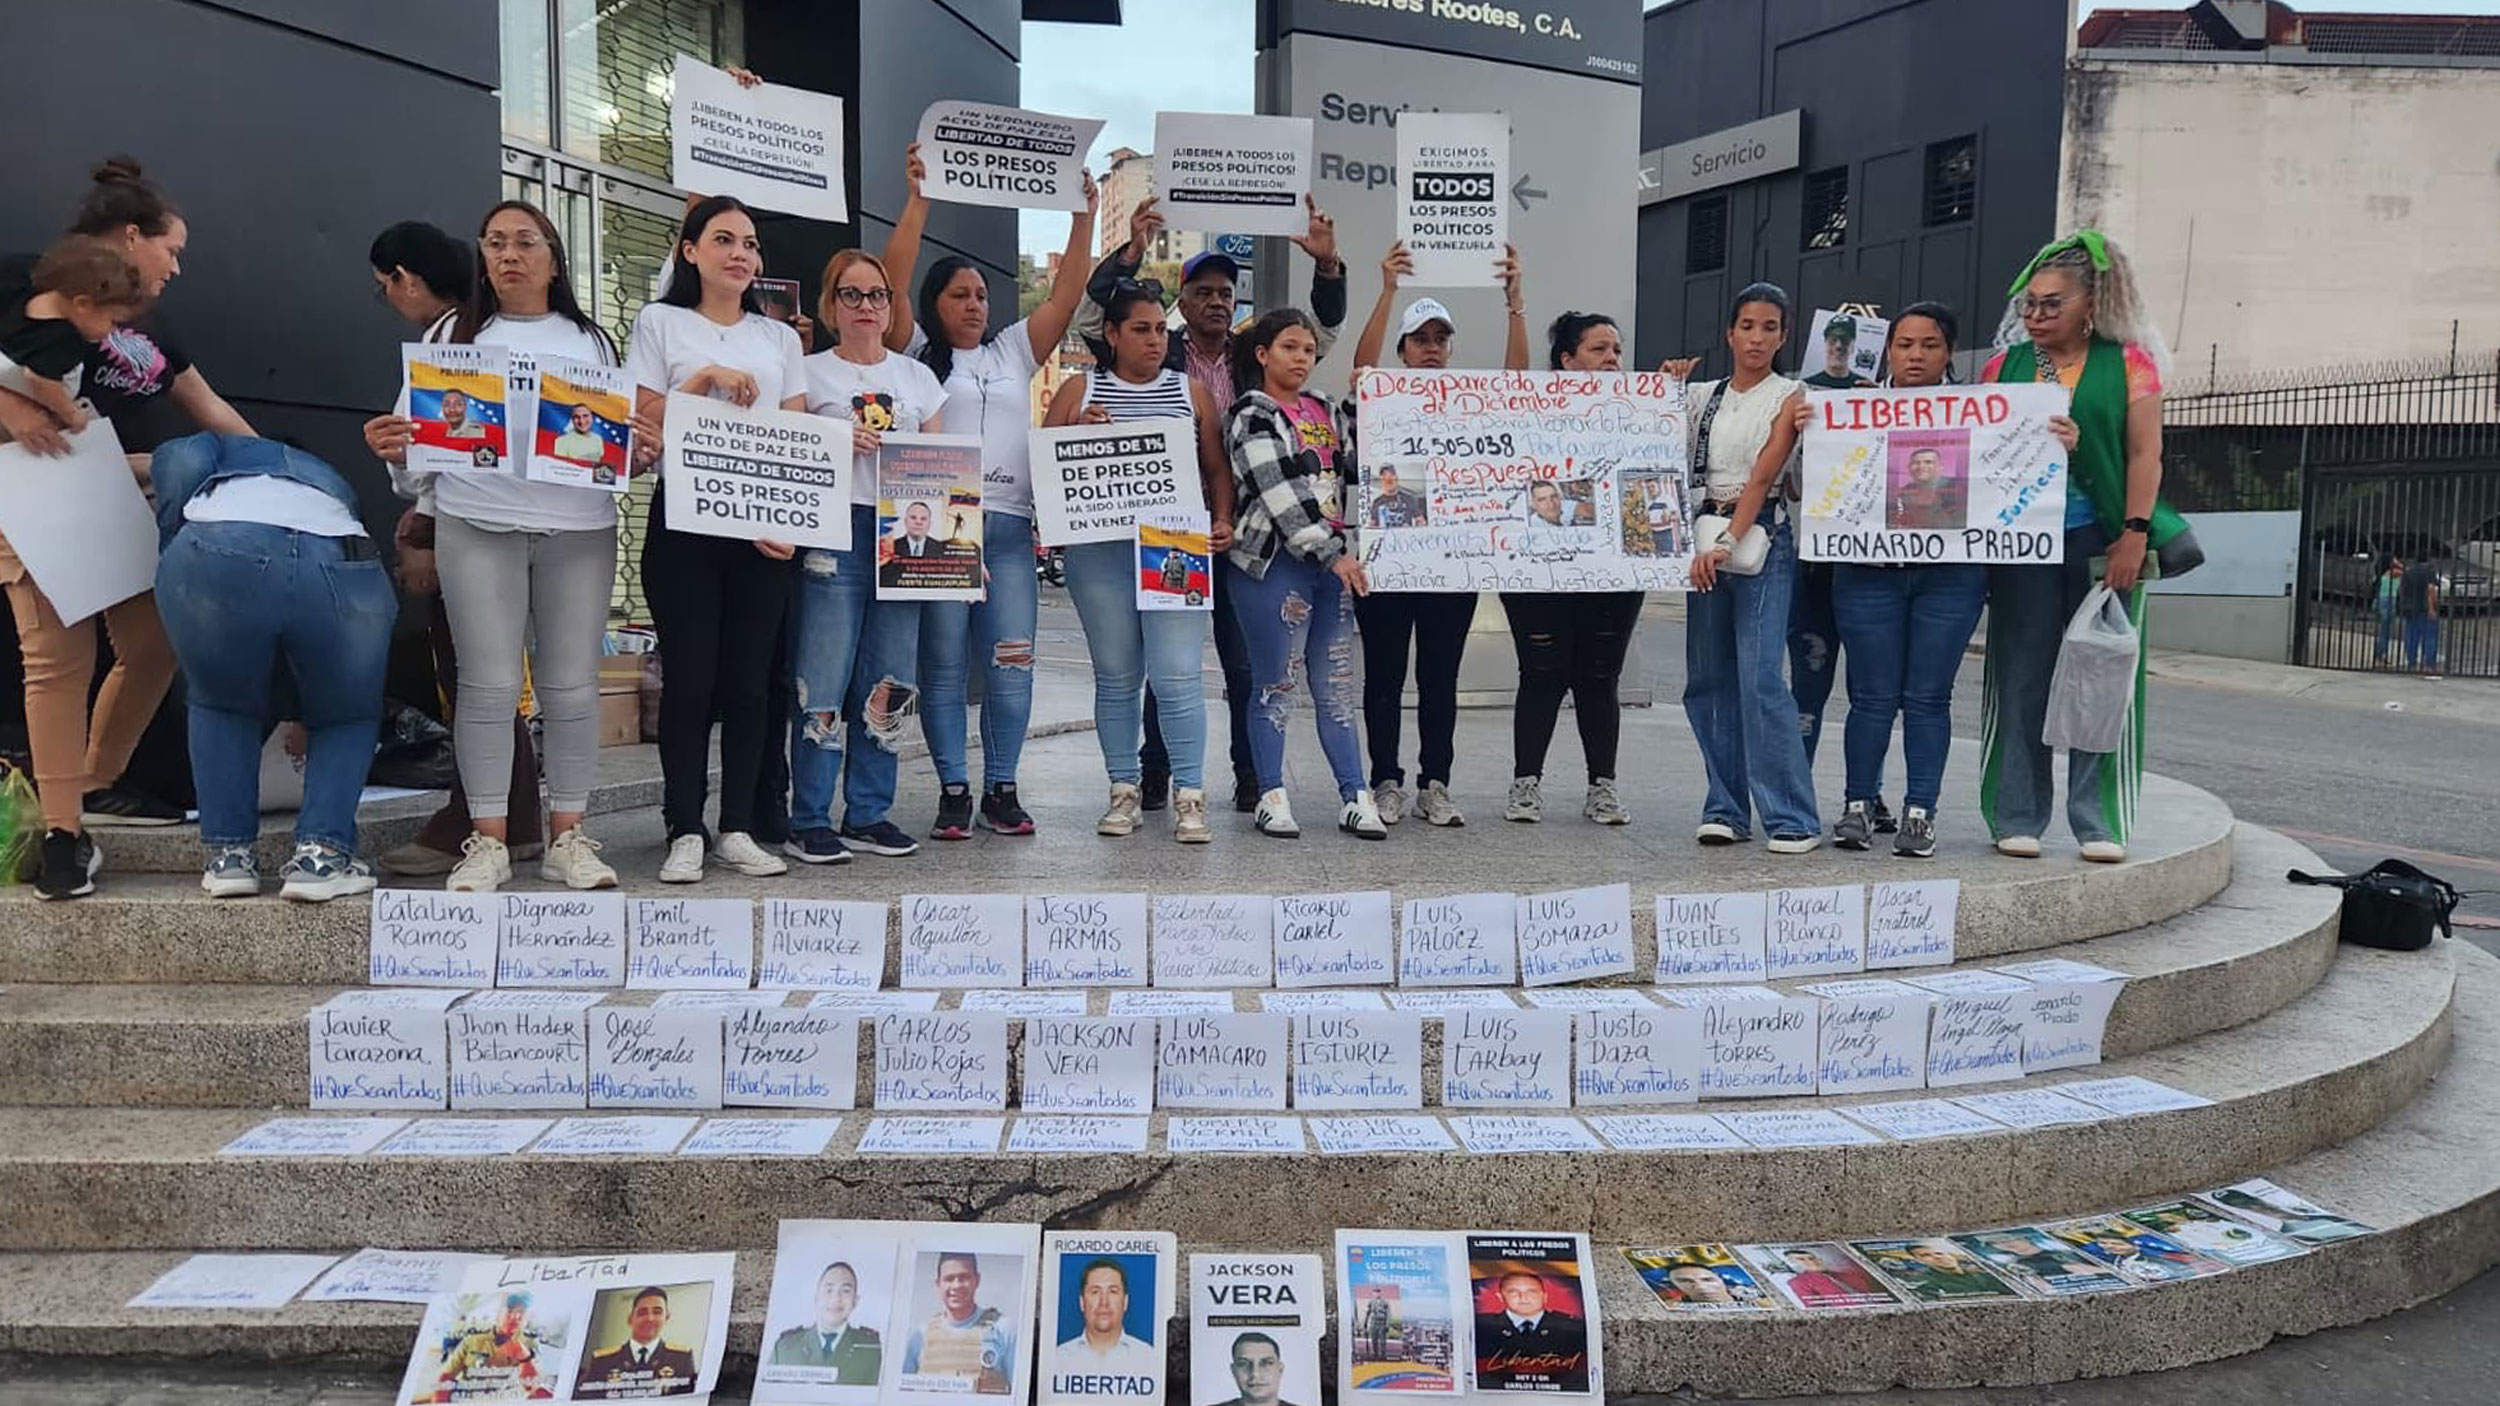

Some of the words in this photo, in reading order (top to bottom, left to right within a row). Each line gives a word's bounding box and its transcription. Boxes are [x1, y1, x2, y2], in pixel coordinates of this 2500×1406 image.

[1535, 13, 1583, 40] C.A.
[744, 115, 754, 127] A
[756, 116, 798, 136] TODOS
[800, 126, 824, 141] LOS
[940, 115, 980, 128] ACTO
[982, 119, 1002, 131] DE
[1004, 122, 1036, 138] PAZ
[960, 108, 981, 119] UN
[983, 111, 1073, 132] VERDADERO
[690, 114, 744, 138] PRESOS
[747, 129, 825, 156] POLÍTICOS!
[937, 129, 1005, 150] LIBERTAD
[1006, 136, 1027, 150] DE
[1028, 139, 1073, 155] TODOS
[943, 148, 980, 167] LOS
[984, 153, 1057, 177] PRESOS
[1226, 149, 1235, 160] A
[1236, 149, 1274, 161] TODOS
[1275, 150, 1296, 162] LOS
[1411, 159, 1458, 169] LIBERTAD
[1461, 159, 1496, 169] PARA
[1418, 146, 1487, 158] EXIGIMOS
[1691, 140, 1767, 177] Servicio
[1172, 160, 1223, 174] PRESOS
[1226, 160, 1296, 176] POLÍTICOS!
[944, 167, 1057, 196] POLÍTICOS
[1414, 176, 1492, 197] TODOS
[1408, 204, 1436, 217] LOS
[1439, 205, 1496, 218] PRESOS
[1411, 219, 1493, 236] POLÍTICOS
[1409, 239, 1428, 250] EN
[1429, 239, 1495, 251] VENEZUELA
[1373, 371, 1535, 402] Desaparecido
[1545, 372, 1602, 396] desde
[1613, 374, 1631, 396] el
[1636, 372, 1666, 398] 28
[1423, 395, 1446, 414] de
[1453, 394, 1570, 415] Diciembre
[1823, 393, 2009, 431] LIBERTAD
[697, 416, 720, 431] UN
[724, 421, 822, 446] VERDADERO
[682, 431, 726, 447] ACTO
[729, 438, 752, 453] DE
[755, 441, 785, 458] PAZ
[790, 446, 808, 461] ES
[812, 451, 832, 464] LA
[1056, 441, 1115, 459] MENOS
[1118, 438, 1142, 452] DE
[685, 451, 757, 474] LIBERTAD
[760, 462, 781, 477] DE
[782, 466, 834, 485] TODOS
[1062, 466, 1089, 482] DE
[1095, 459, 1173, 478] PRESOS
[693, 476, 735, 496] LOS
[741, 483, 820, 507] PRESOS
[1064, 478, 1175, 502] POLÍTICOS
[695, 498, 820, 529] POLÍTICOS
[1065, 504, 1080, 514] HA
[1085, 500, 1115, 512] SIDO
[1118, 495, 1177, 510] LIBERADO
[1069, 519, 1087, 531] EN
[1089, 515, 1137, 529] VENEZ
[1813, 531, 1945, 560] LEONARDO
[1962, 528, 2053, 560] PRADO
[379, 892, 483, 925] Catalina
[639, 900, 692, 925] Emil
[773, 900, 843, 936] HENRY
[1037, 896, 1108, 928] JESUS
[1413, 901, 1463, 925] LUIS
[1528, 897, 1576, 921] LUIS
[1048, 927, 1122, 952] ARMAS
[457, 1012, 508, 1037] Jhon
[880, 1014, 973, 1046] CARLOS
[1032, 1018, 1136, 1049] JACKSON
[1173, 1017, 1221, 1041] LUIS
[1305, 1014, 1360, 1039] LUIS
[1463, 1010, 1519, 1042] LUIS
[1043, 1049, 1099, 1077] VERA
[1162, 1041, 1268, 1068] CAMACARO
[1591, 1040, 1653, 1065] Daza
[1055, 1240, 1113, 1253] RICARDO
[1115, 1240, 1161, 1253] CARIEL
[1206, 1263, 1294, 1277] JACKSON
[1207, 1284, 1297, 1305] VERA
[1053, 1375, 1155, 1396] LIBERTAD
